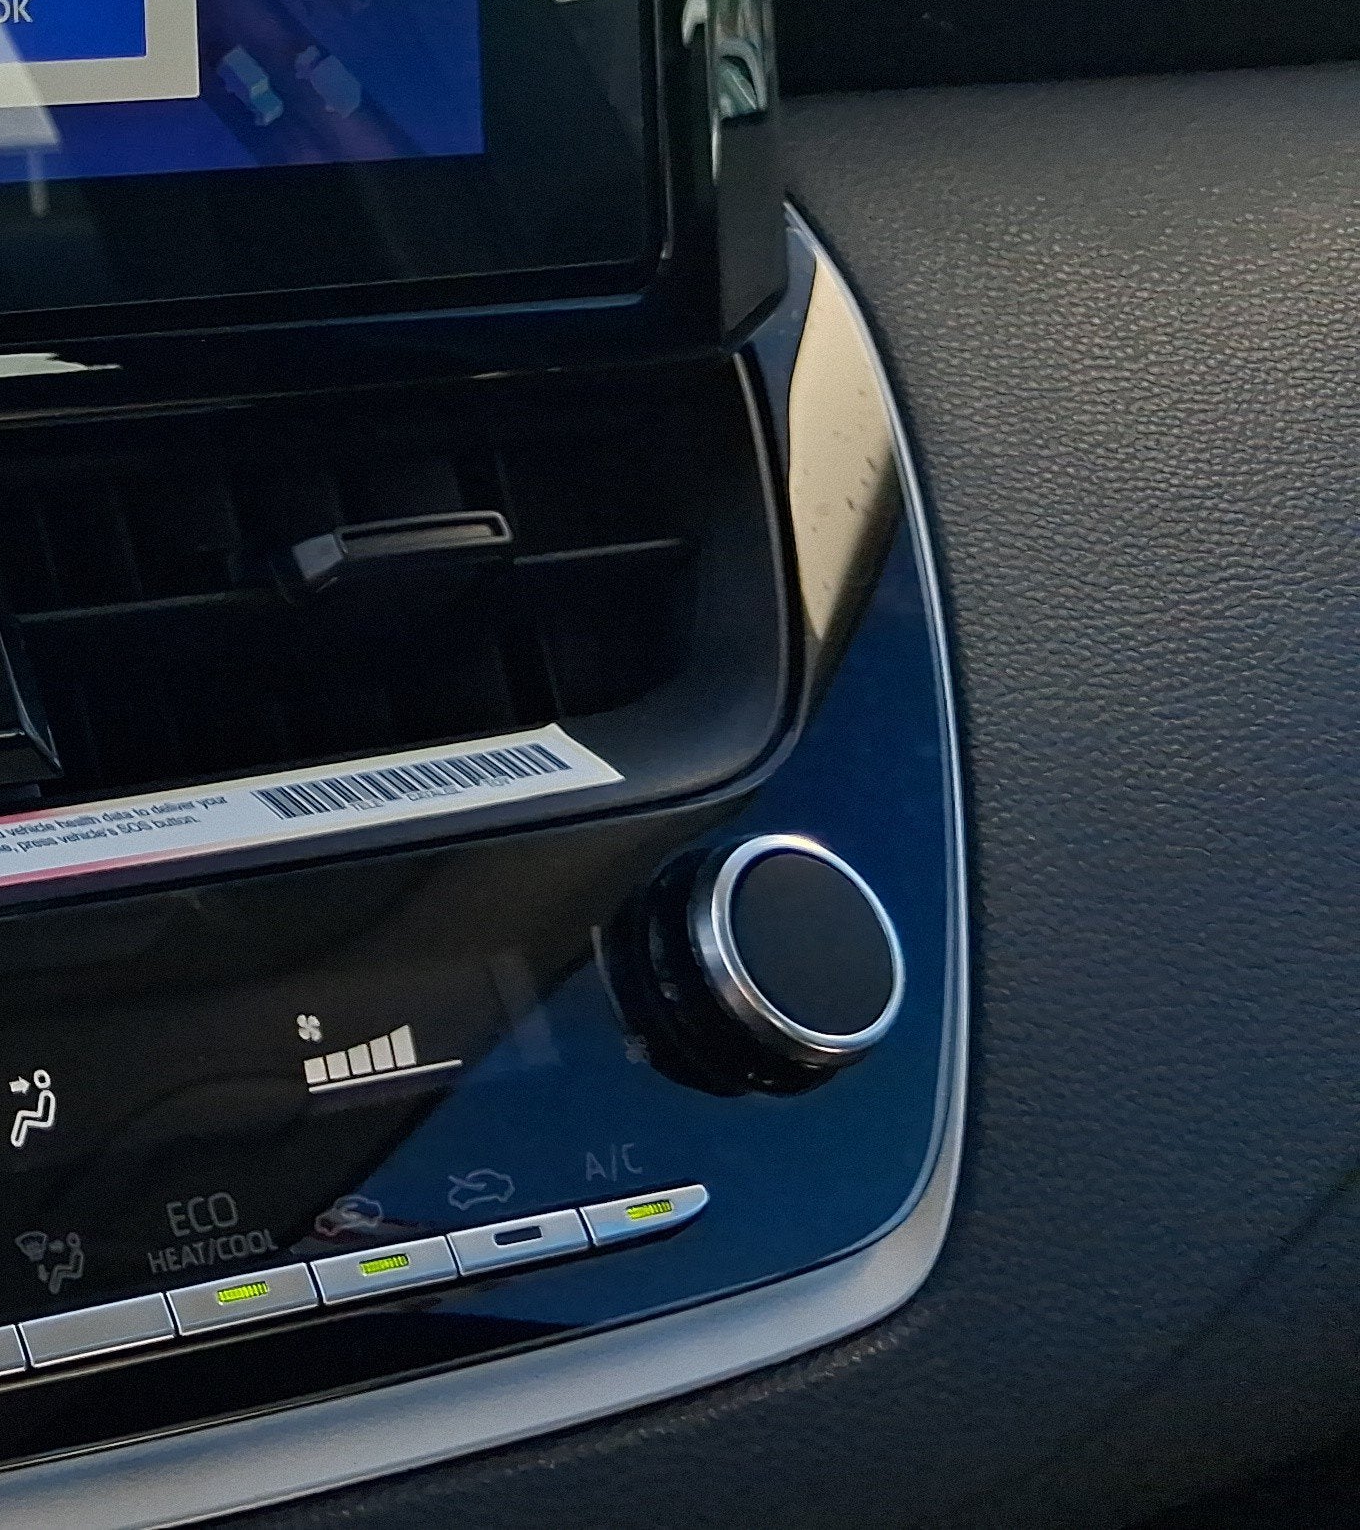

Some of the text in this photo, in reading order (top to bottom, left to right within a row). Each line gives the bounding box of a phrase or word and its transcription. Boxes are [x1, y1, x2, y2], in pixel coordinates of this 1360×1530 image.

[5, 820, 55, 837] vehicle
[55, 813, 102, 829] health
[102, 810, 133, 822] data
[133, 807, 151, 818] to
[196, 795, 228, 810] your
[18, 836, 59, 853] press
[117, 821, 154, 835] SOS
[585, 1142, 644, 1182] A/C
[166, 1192, 238, 1237] ECO
[147, 1229, 279, 1273] HEAT/COOL
